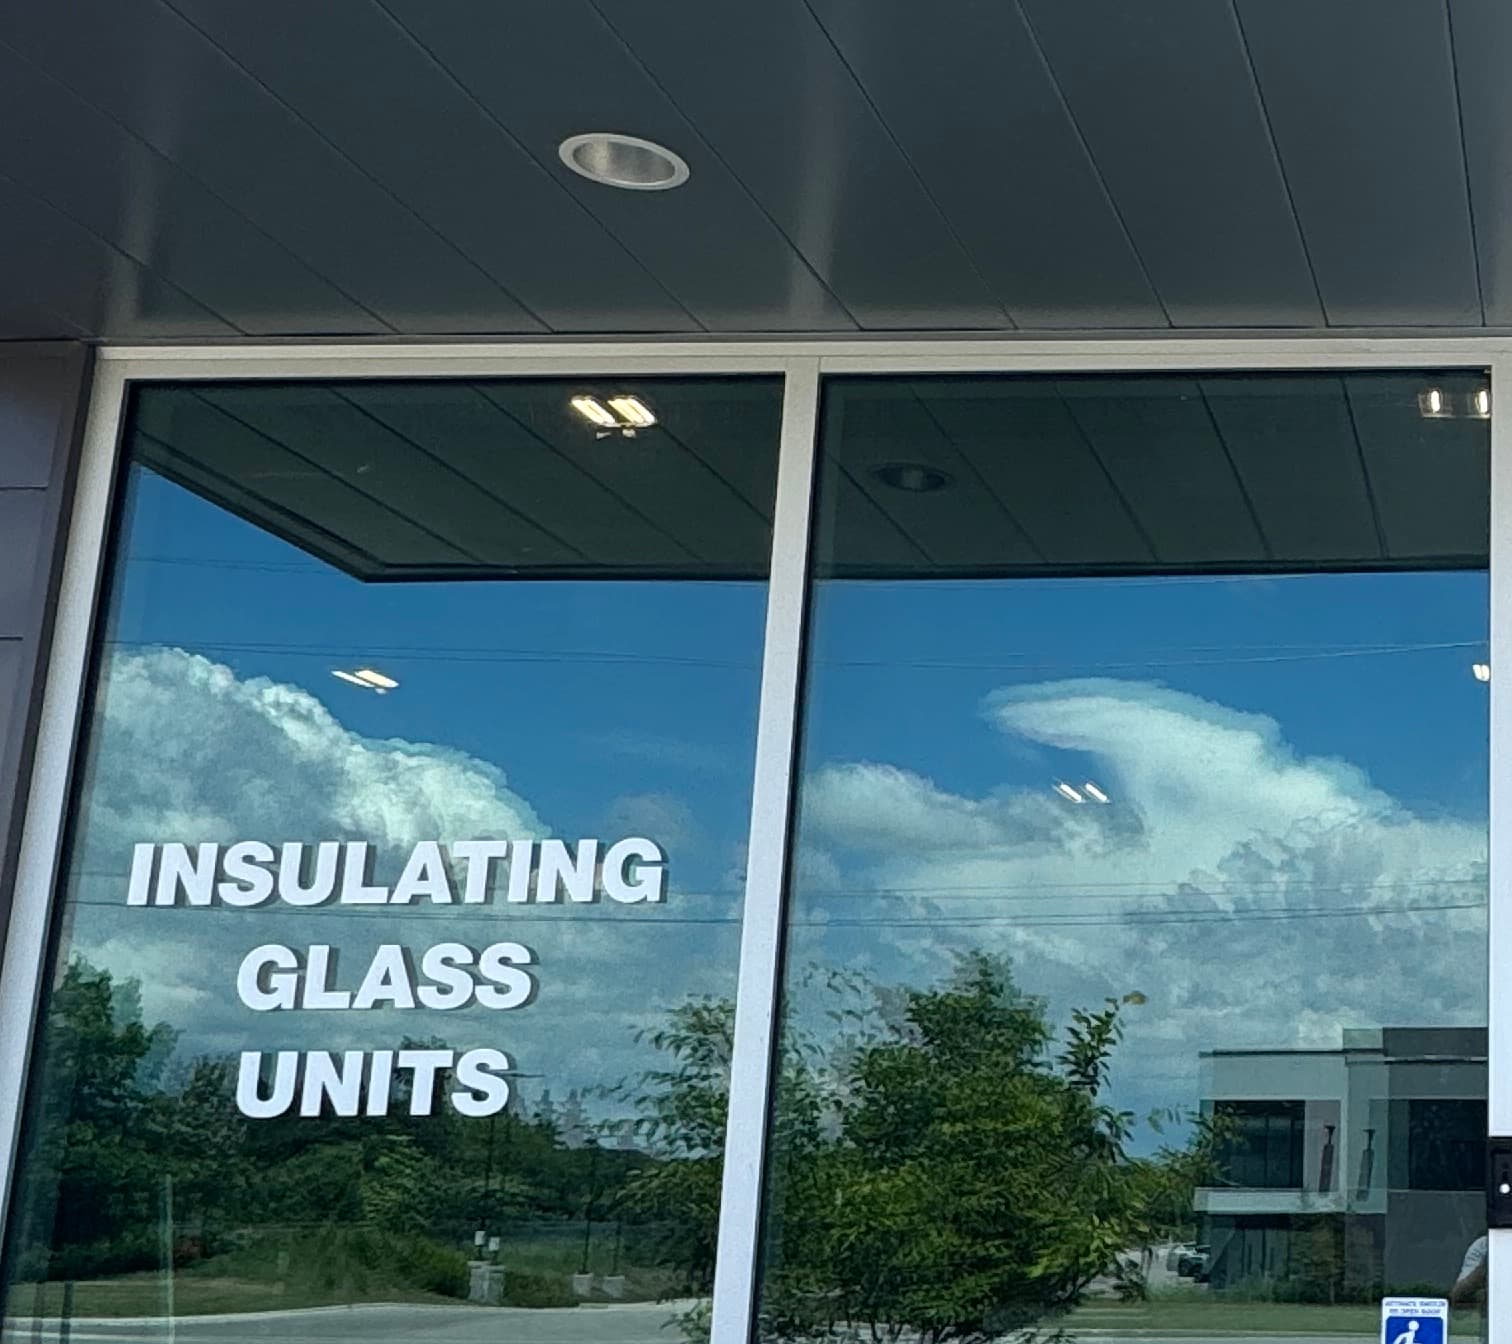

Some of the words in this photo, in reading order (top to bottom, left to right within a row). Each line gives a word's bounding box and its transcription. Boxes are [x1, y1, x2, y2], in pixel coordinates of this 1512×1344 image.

[126, 837, 664, 906] INSULATING
[236, 943, 533, 1009] GLASS
[236, 1049, 510, 1118] UNITS
